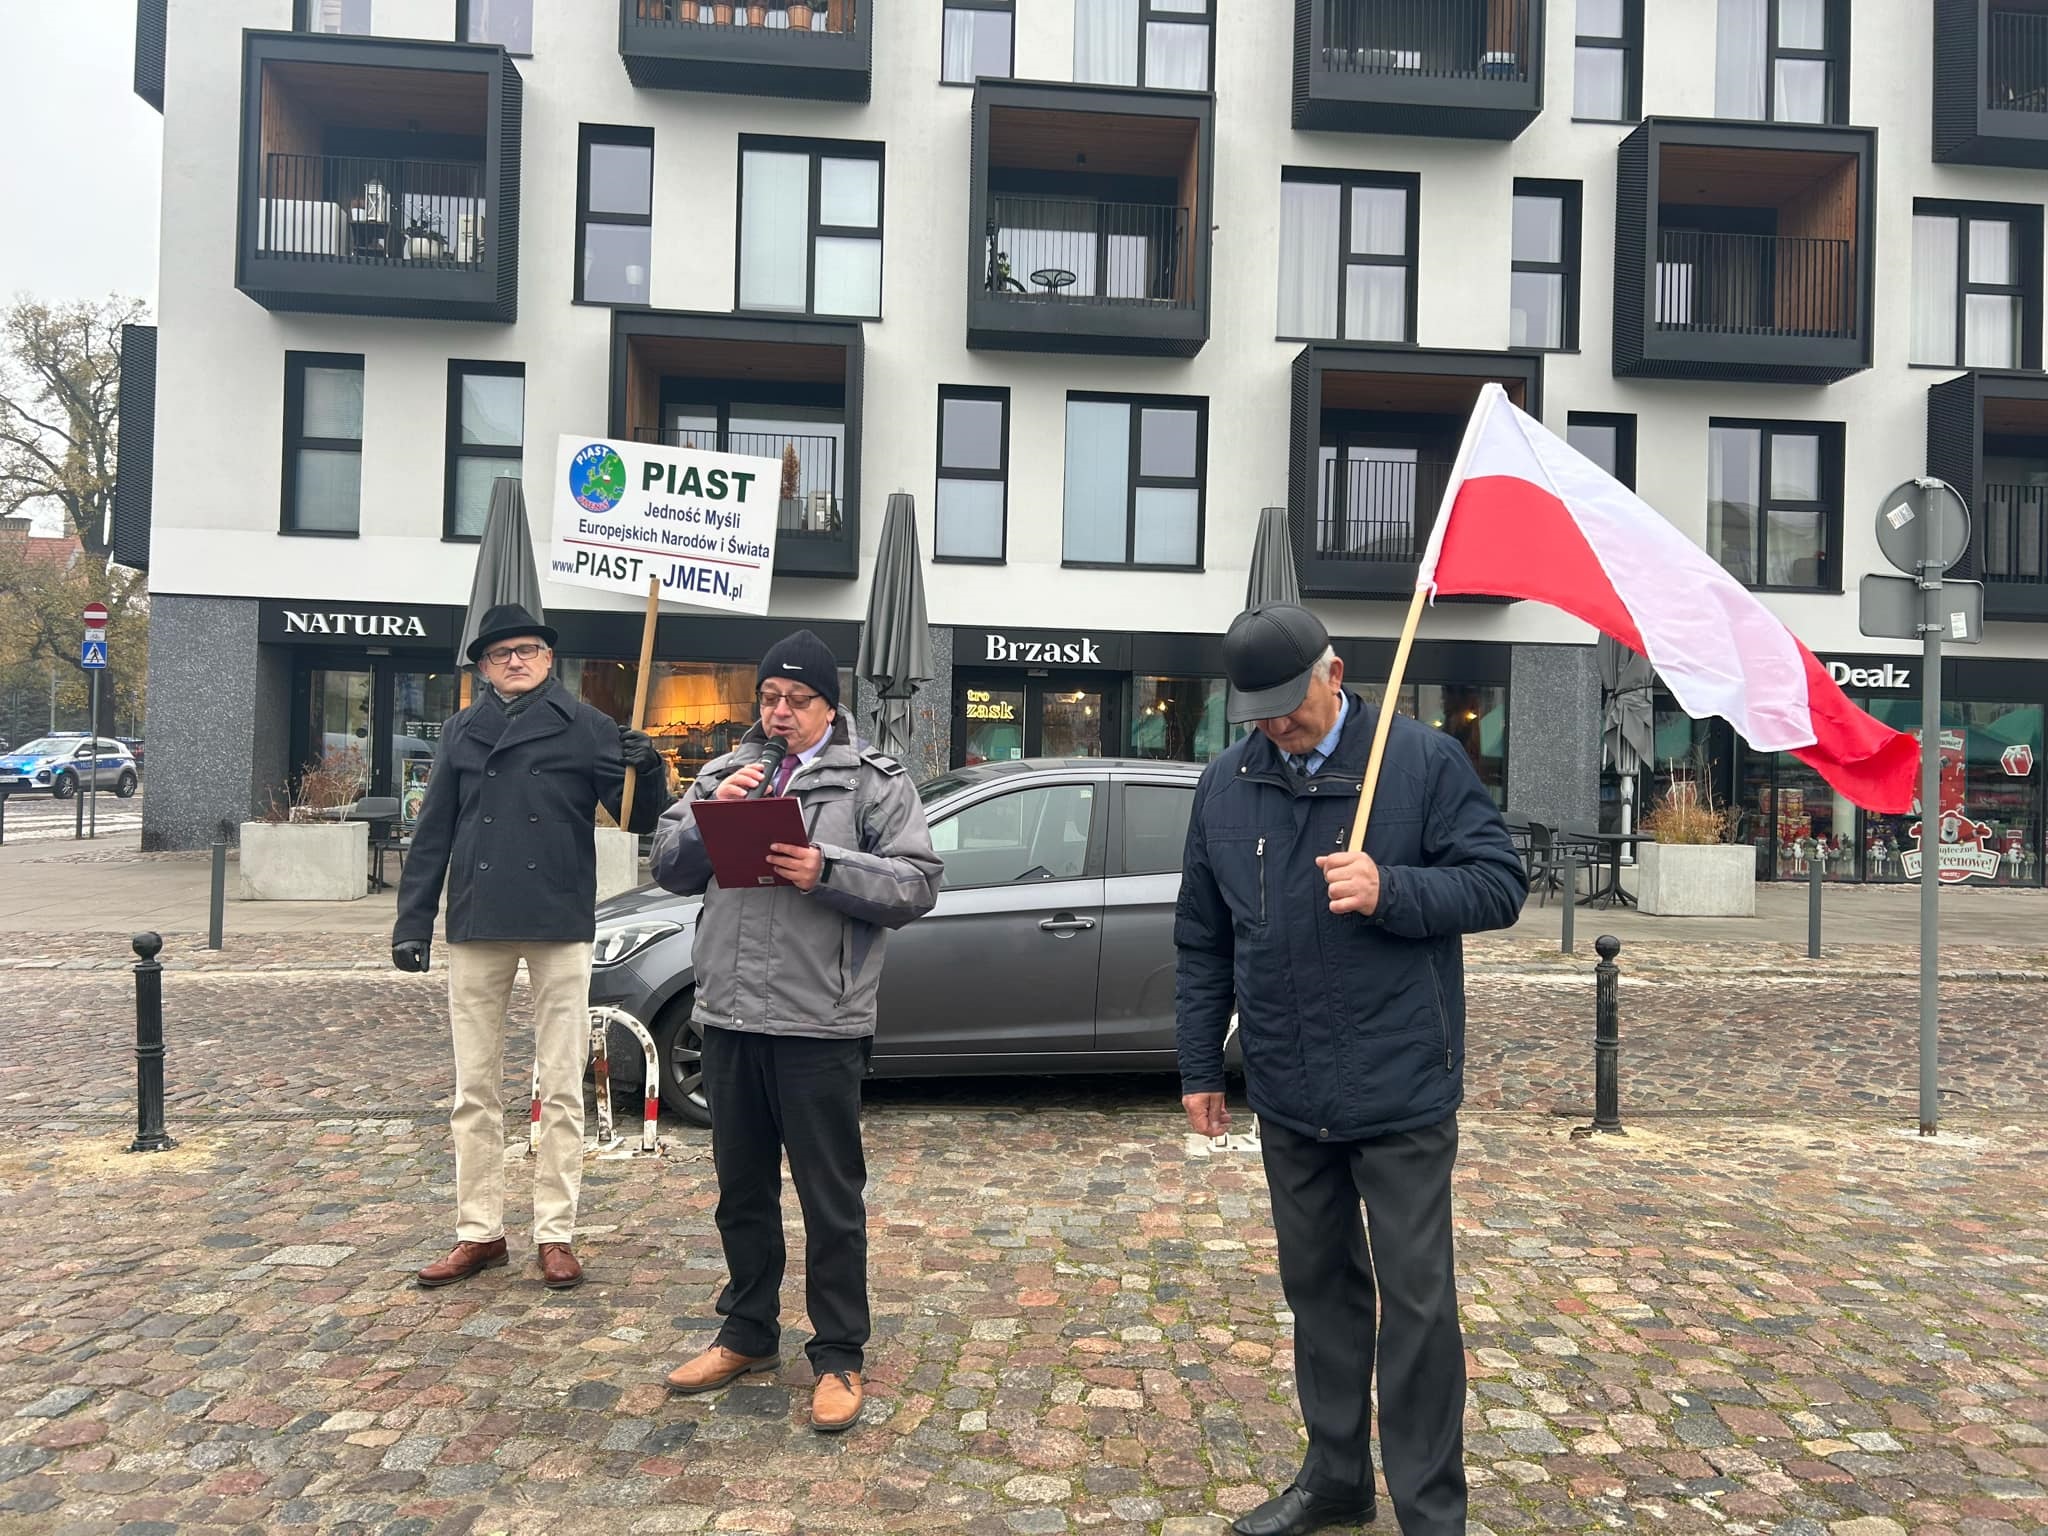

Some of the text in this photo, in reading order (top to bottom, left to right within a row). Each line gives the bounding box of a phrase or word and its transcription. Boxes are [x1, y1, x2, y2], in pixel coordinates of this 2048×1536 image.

[576, 446, 609, 465] PIAST
[641, 461, 756, 503] PIAST
[644, 502, 741, 530] Jedność Myśli
[579, 518, 770, 559] Europejskich Narodów i Świata
[282, 610, 427, 637] NATURA
[985, 634, 1102, 664] Brzask
[1826, 661, 1911, 688] Dealz
[966, 701, 1015, 719] zask
